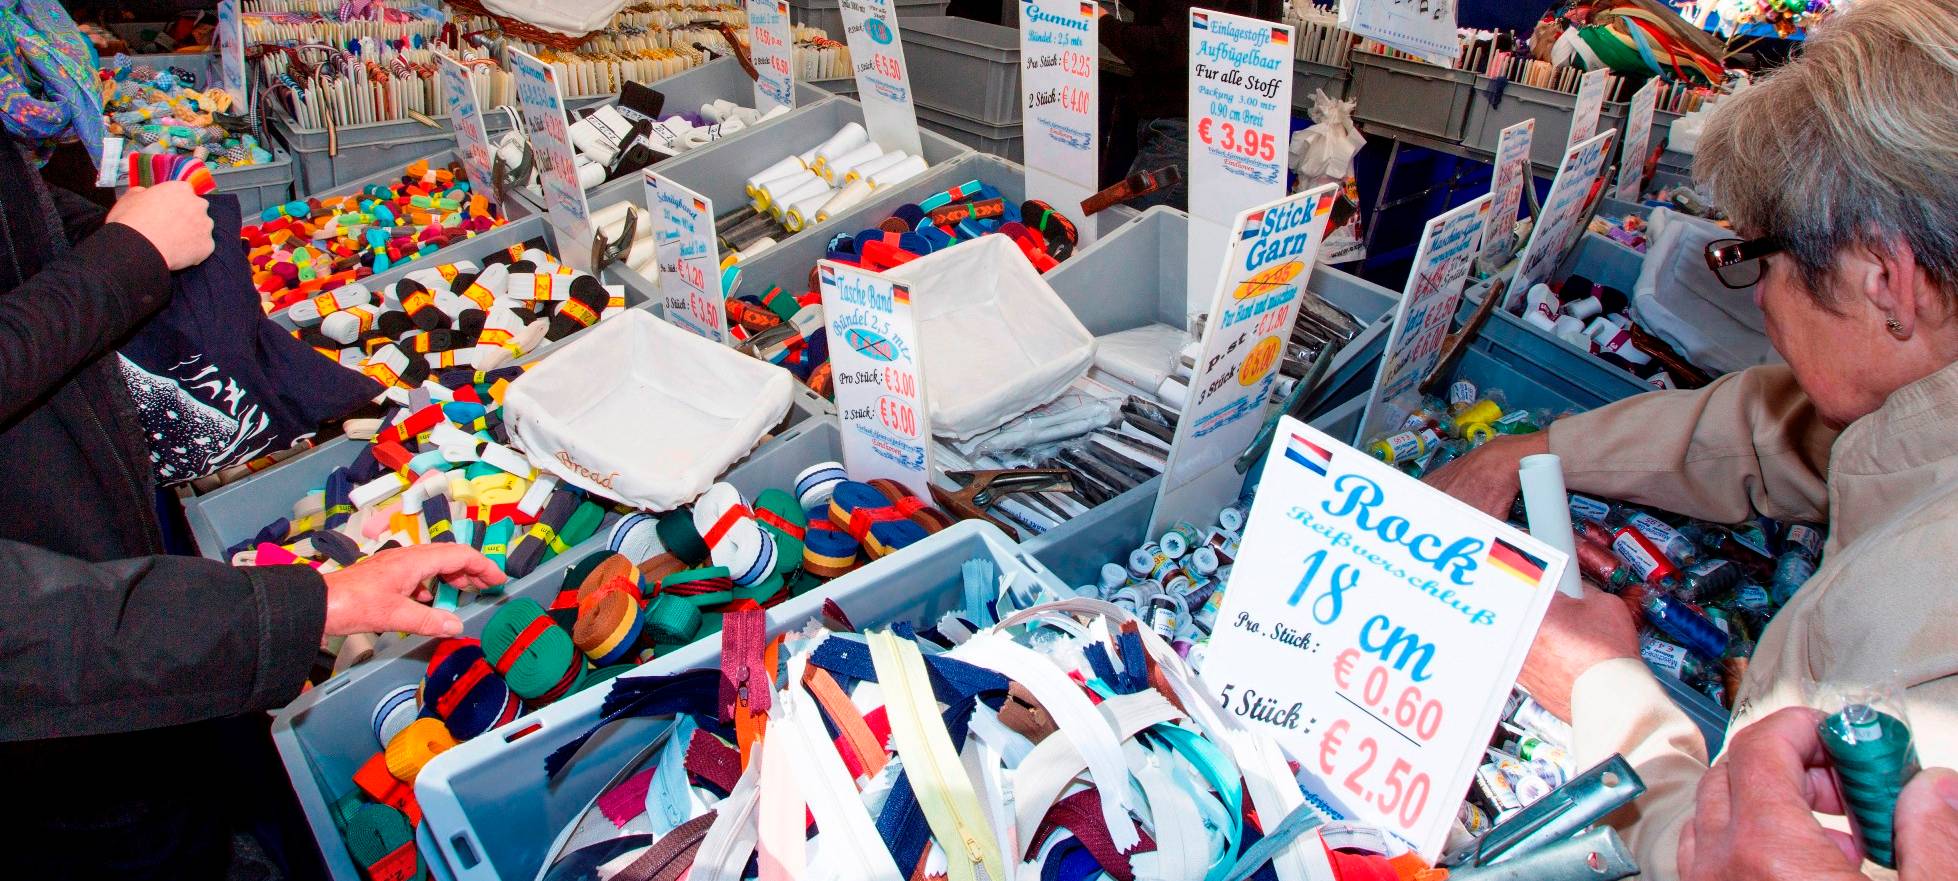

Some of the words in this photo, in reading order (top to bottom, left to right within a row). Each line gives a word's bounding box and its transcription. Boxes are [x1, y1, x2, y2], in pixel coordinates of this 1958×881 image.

[1025, 4, 1089, 32] Gummi
[1210, 20, 1270, 47] Einlagestoffe
[1062, 50, 1070, 73] €
[1071, 52, 1091, 79] 2.25
[1196, 40, 1282, 71] Aufbügelbaar
[1195, 63, 1219, 80] Fur
[1220, 69, 1242, 86] alle
[1244, 75, 1282, 99] Stoff
[1198, 85, 1234, 101] Packung
[1028, 92, 1034, 109] 2
[1061, 85, 1069, 109] €
[1070, 86, 1089, 115] 4.00
[1210, 102, 1228, 118] 0.90
[1229, 109, 1241, 121] cm
[1242, 110, 1265, 128] Breit
[1197, 117, 1213, 145] €
[1220, 122, 1275, 161] 3.95
[1260, 195, 1315, 238] Stick
[1245, 230, 1308, 272] Garn
[690, 291, 698, 318] €
[699, 296, 719, 330] 3.50
[837, 277, 867, 306] Tasche
[868, 285, 894, 314] Band
[833, 310, 868, 338] Bündel
[871, 315, 889, 335] 2,5
[839, 371, 854, 385] Pro
[884, 366, 892, 391] €
[893, 369, 915, 399] 3.00
[844, 409, 849, 420] 2
[880, 397, 889, 426] €
[890, 400, 915, 437] 5.00
[1321, 473, 1485, 586] Rock
[1286, 505, 1496, 627] Reißverschluß
[1286, 549, 1361, 626] 18
[1359, 614, 1436, 683] cm
[1219, 683, 1235, 710] 5
[1332, 648, 1360, 690] €
[1362, 665, 1444, 741] 0.60
[1319, 718, 1351, 776] €
[1343, 736, 1431, 830] 2.50
